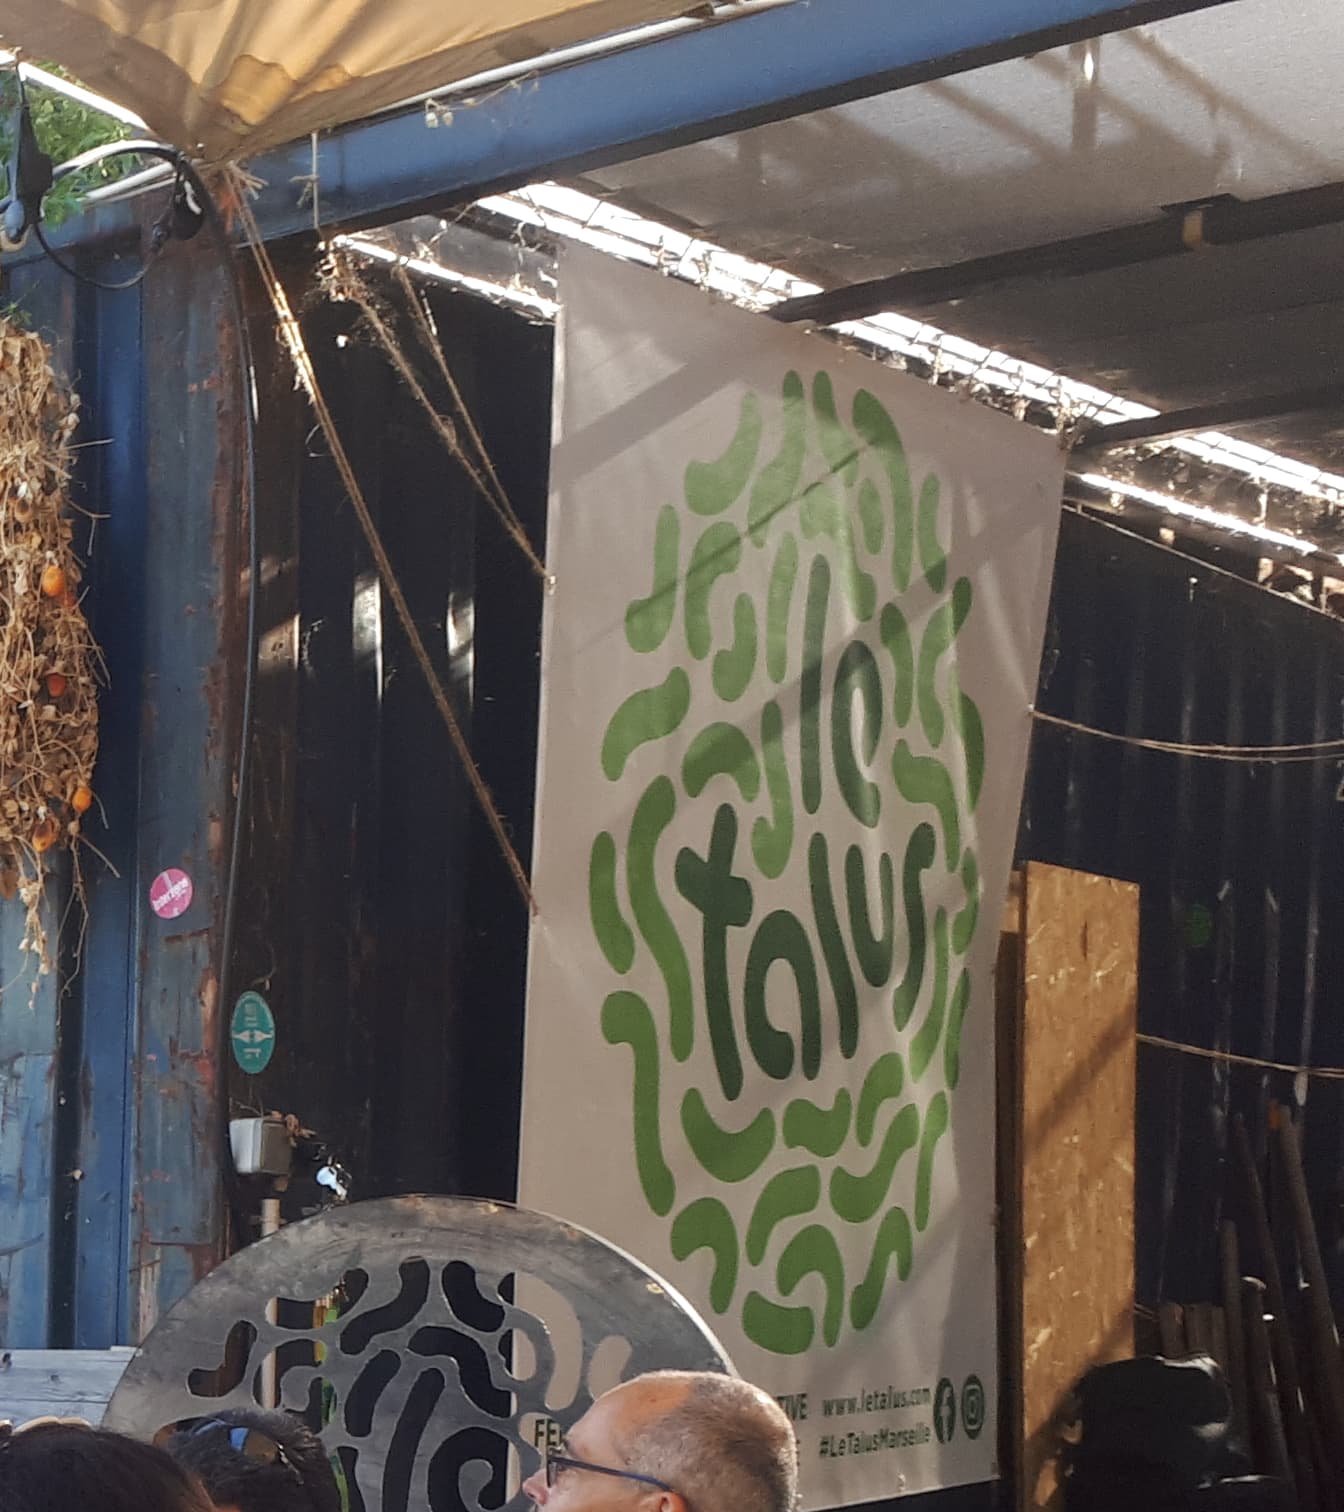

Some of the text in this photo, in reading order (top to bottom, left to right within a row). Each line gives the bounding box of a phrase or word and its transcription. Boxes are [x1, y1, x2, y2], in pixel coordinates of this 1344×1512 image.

[801, 554, 883, 829] le
[674, 802, 936, 1101] talus
[819, 1422, 932, 1458] #LeTalusMarseille
[822, 1385, 932, 1417] www.letalus.com
